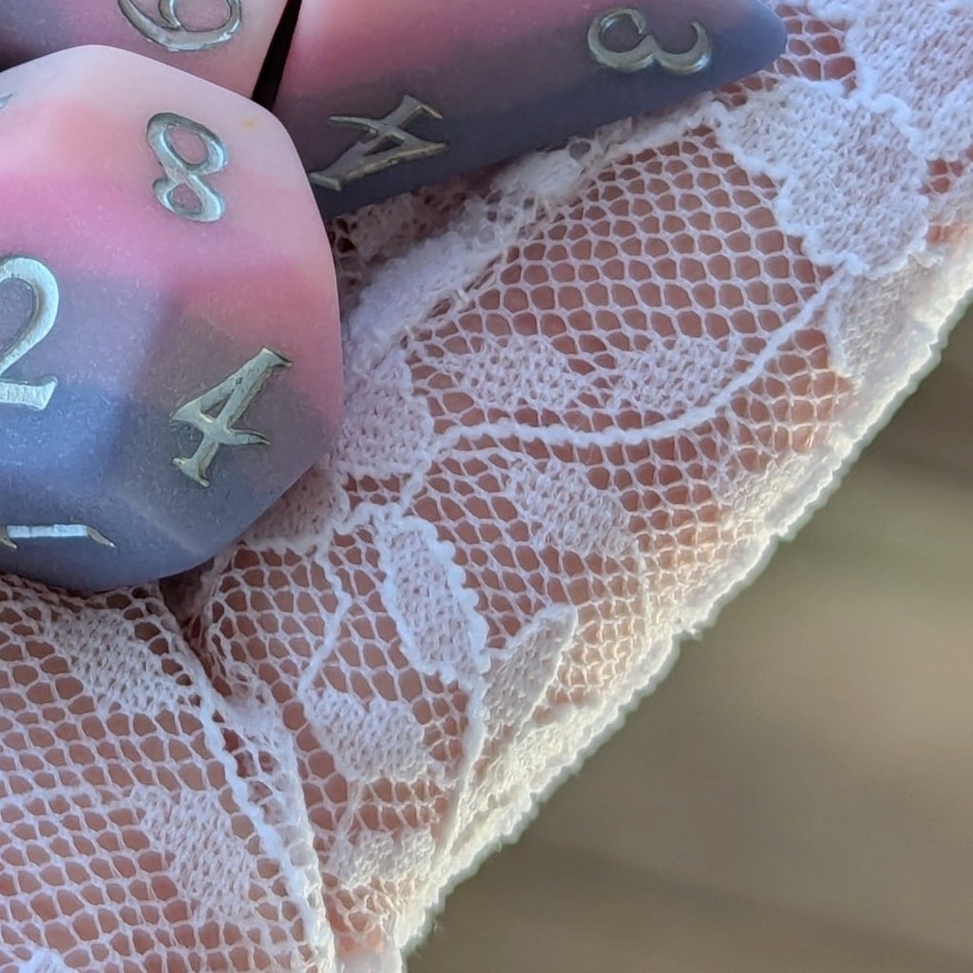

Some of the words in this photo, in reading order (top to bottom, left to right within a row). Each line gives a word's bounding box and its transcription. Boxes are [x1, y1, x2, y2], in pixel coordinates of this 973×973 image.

[585, 6, 713, 77] 3
[145, 110, 229, 224] 8
[308, 93, 450, 192] 4
[170, 345, 295, 489] 4
